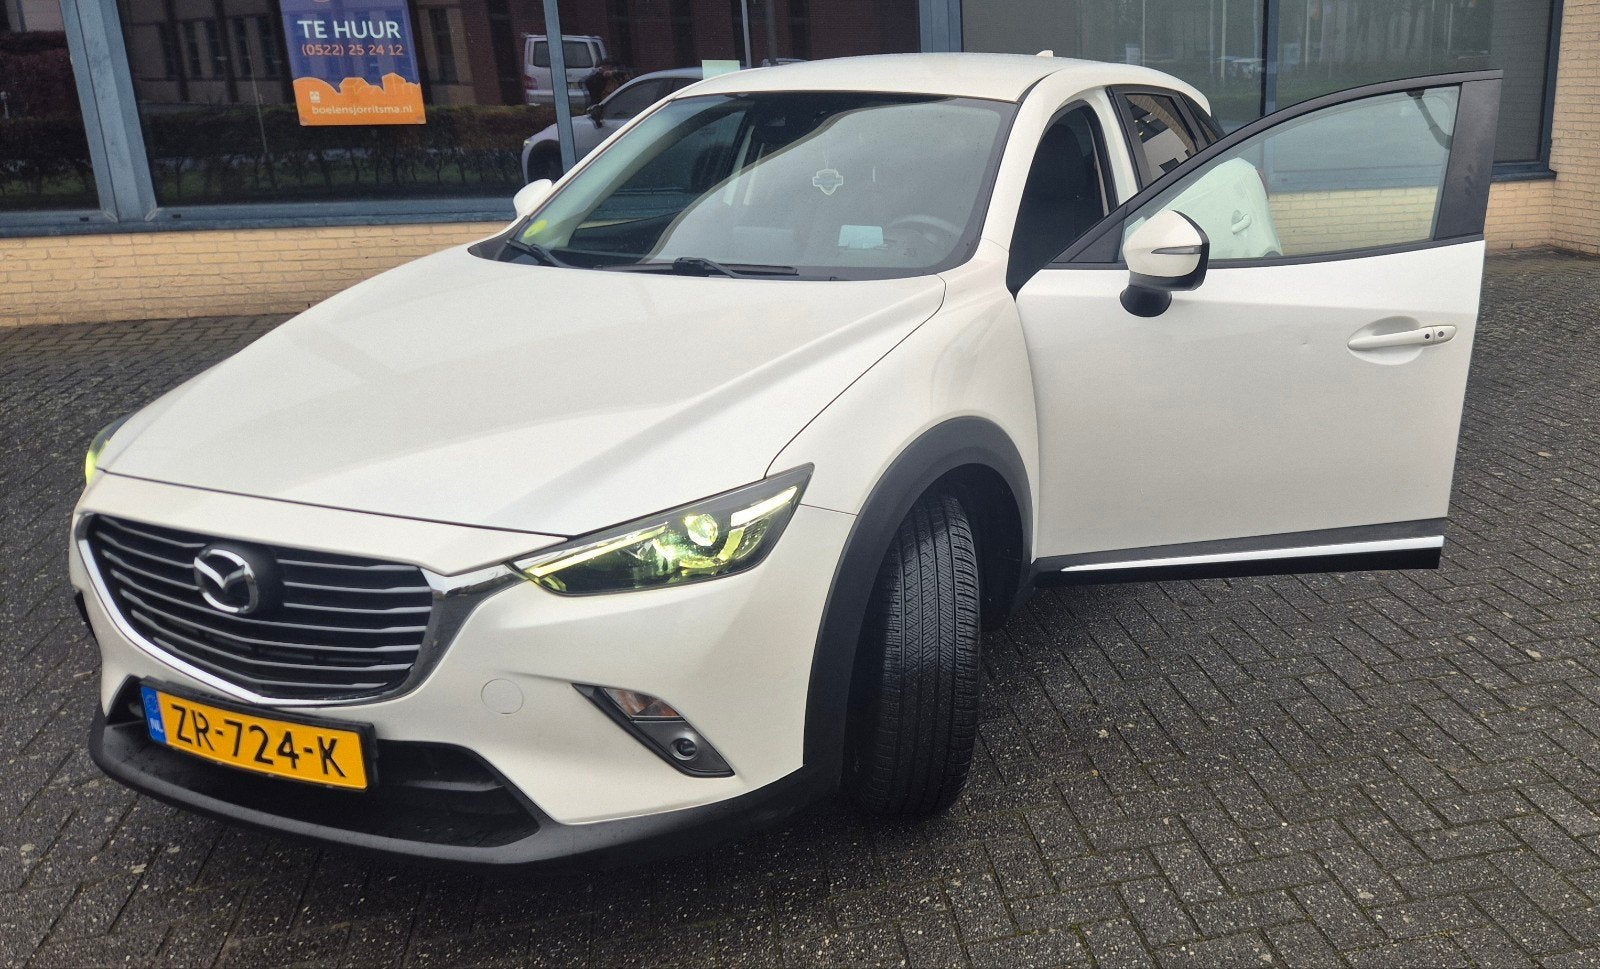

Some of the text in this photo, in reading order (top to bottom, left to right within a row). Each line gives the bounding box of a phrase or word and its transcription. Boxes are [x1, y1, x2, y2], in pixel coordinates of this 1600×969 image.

[297, 20, 401, 39] TE HUUR
[302, 44, 404, 56] (0522) 25 24 12
[312, 104, 413, 116] boelensjorritsma.nl
[150, 717, 163, 733] NL
[171, 703, 346, 778] ZR-724-K
